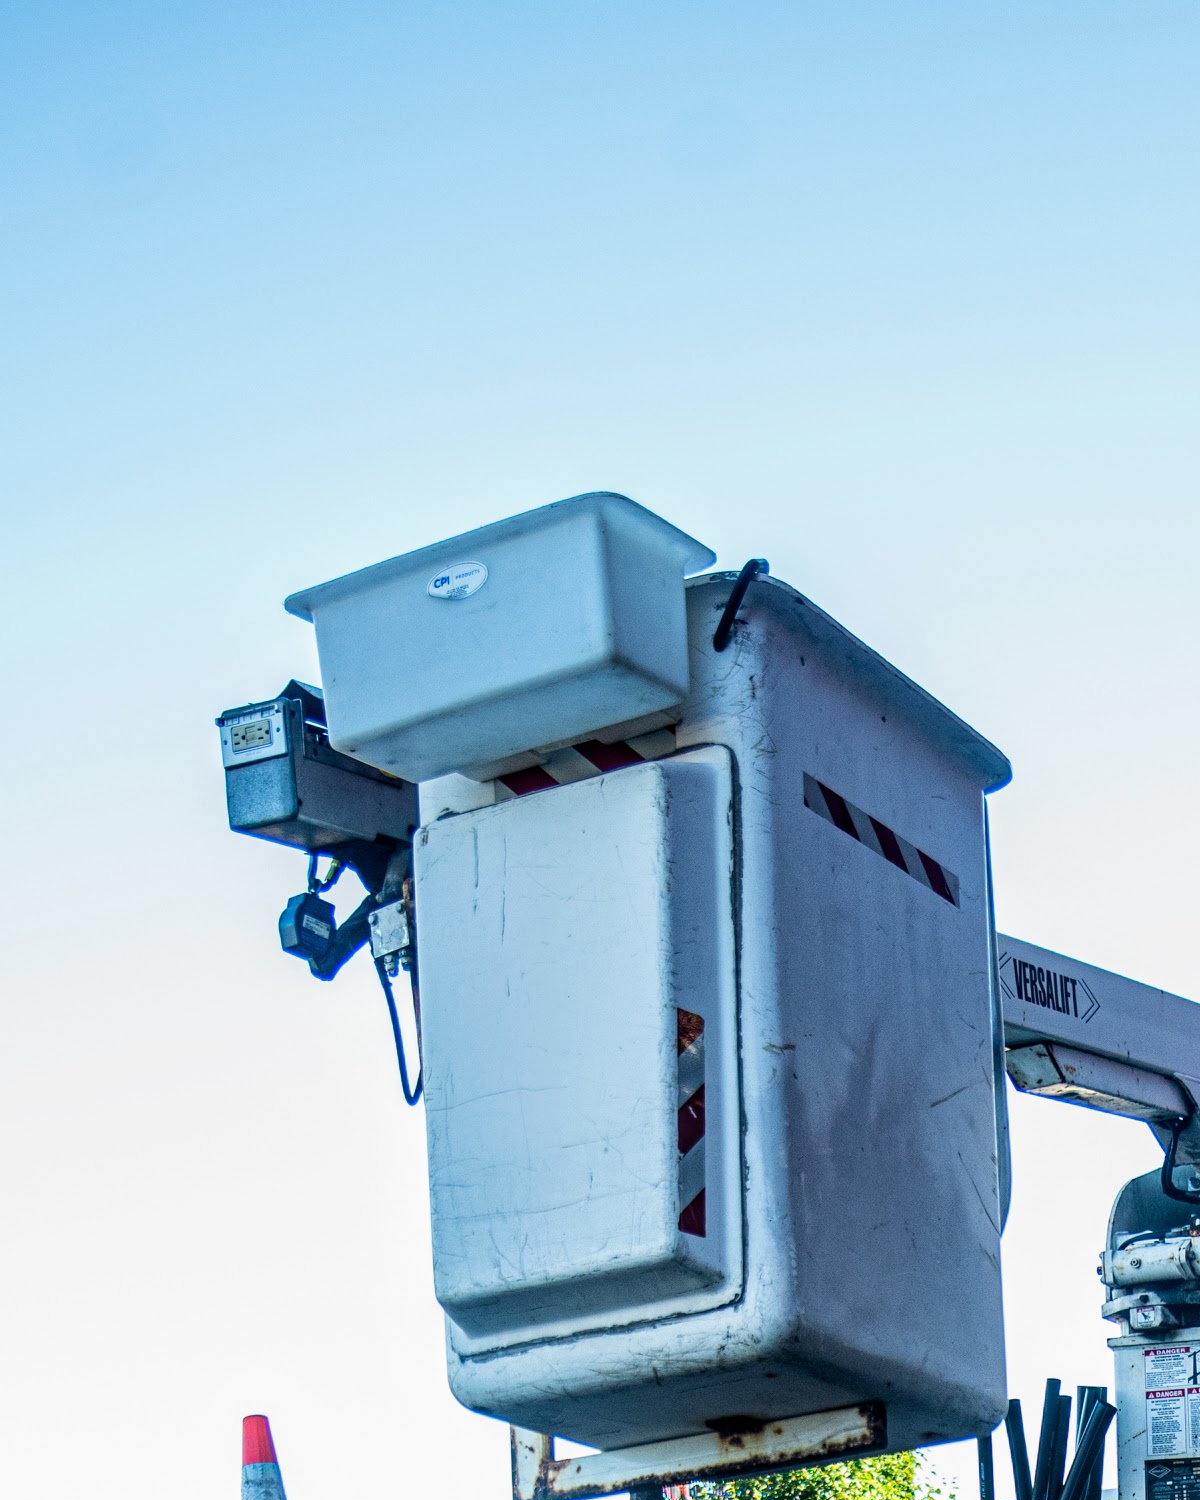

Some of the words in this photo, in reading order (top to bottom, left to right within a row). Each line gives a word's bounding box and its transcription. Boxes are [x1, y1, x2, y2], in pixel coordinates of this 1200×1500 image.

[433, 576, 450, 589] CPI
[455, 569, 480, 580] PRODUCTS
[1012, 957, 1079, 1018] VERSALIFT
[1155, 1390, 1183, 1398] DANGER
